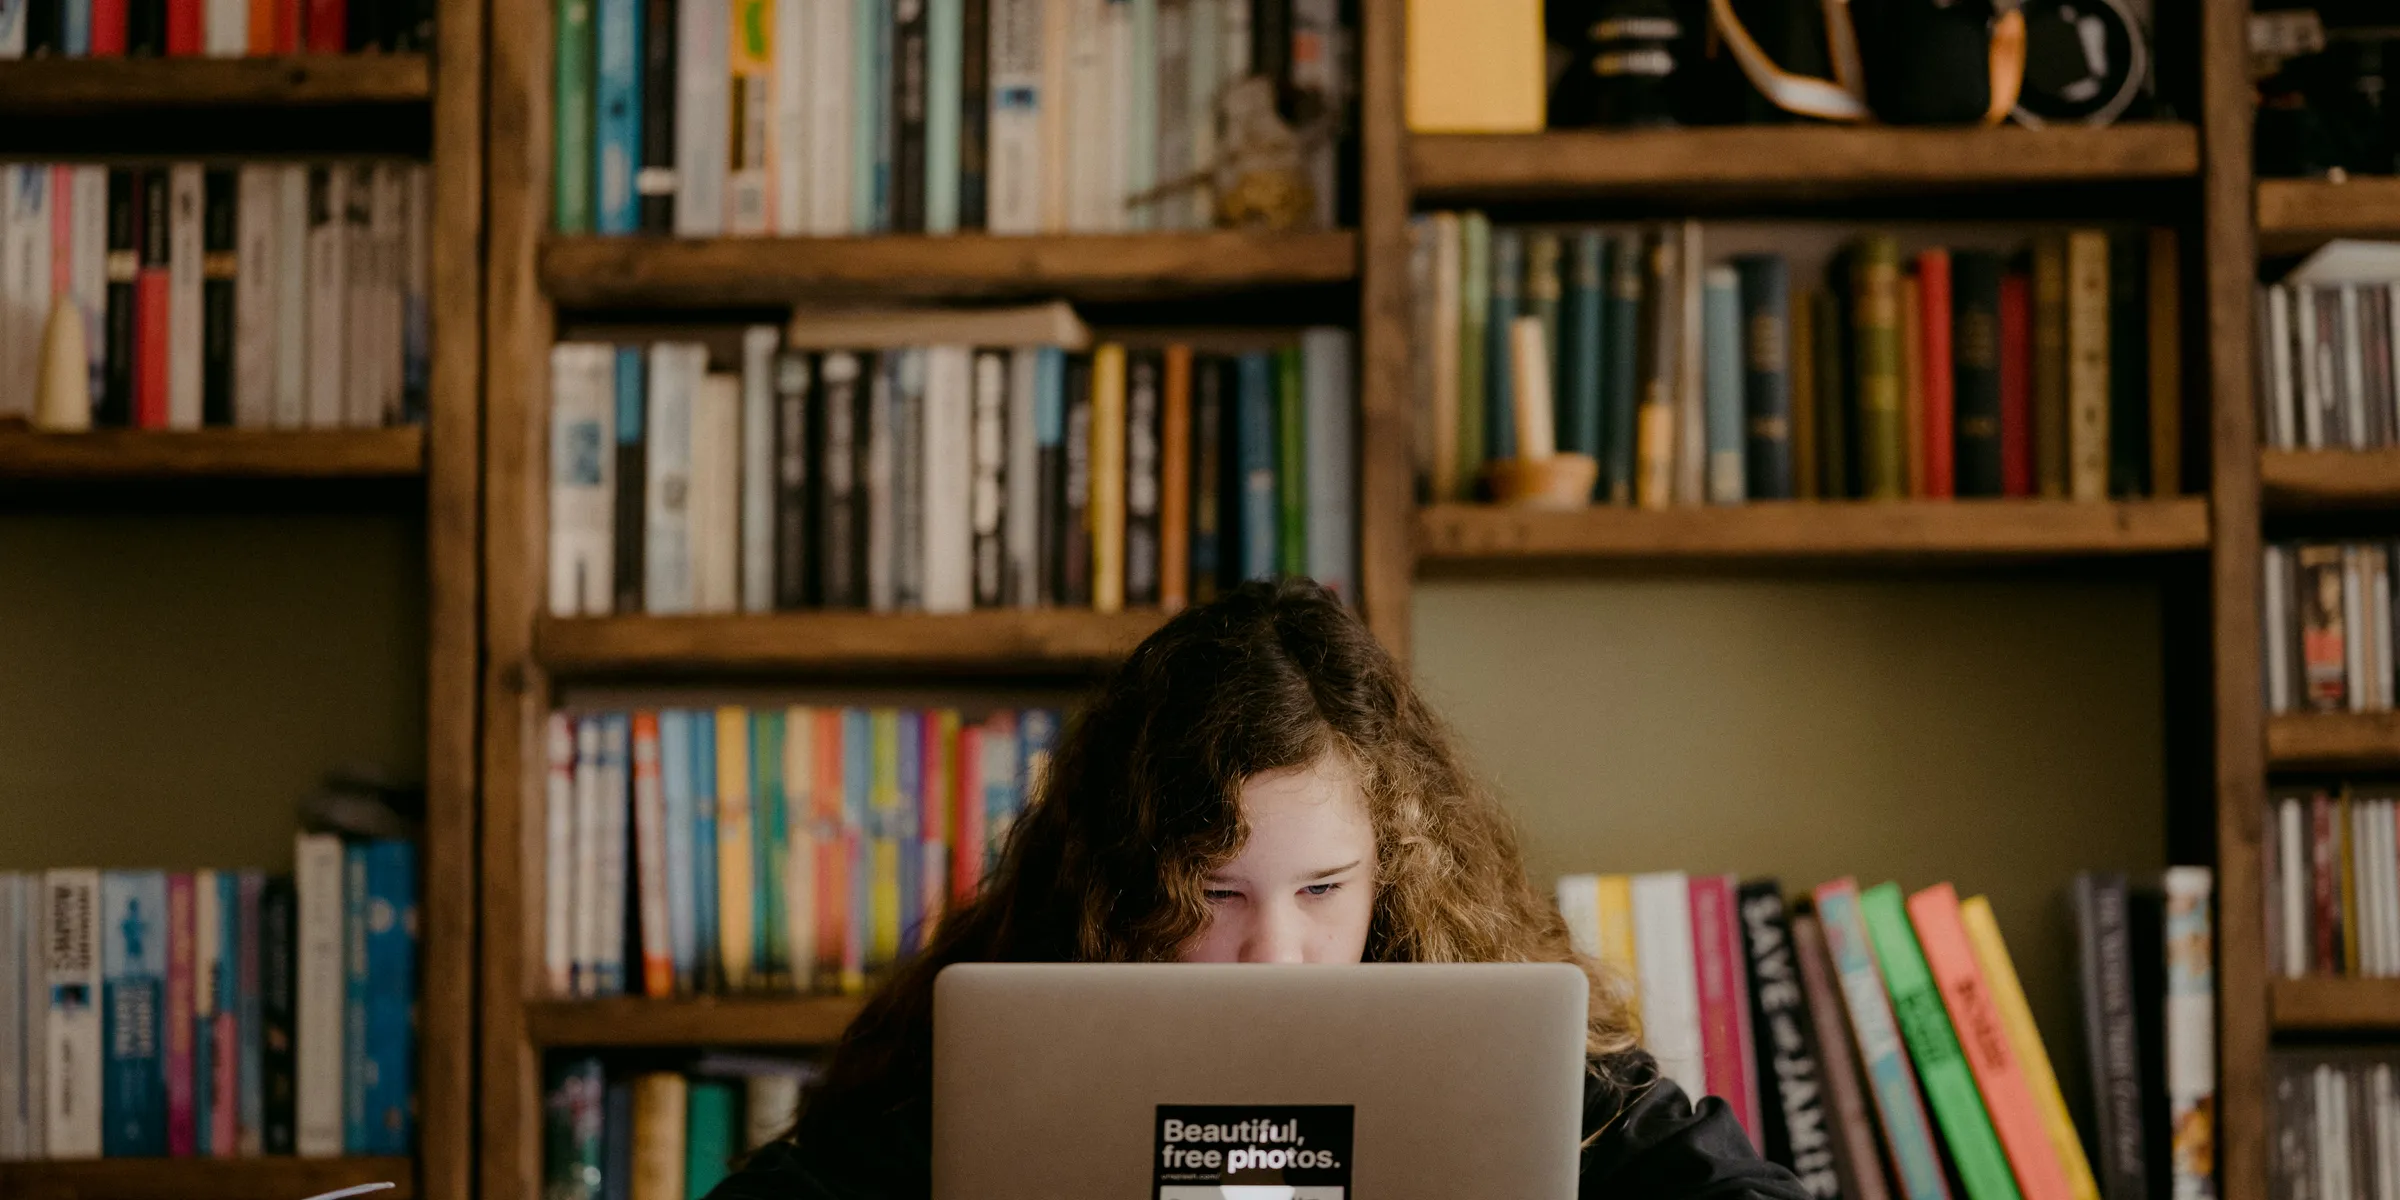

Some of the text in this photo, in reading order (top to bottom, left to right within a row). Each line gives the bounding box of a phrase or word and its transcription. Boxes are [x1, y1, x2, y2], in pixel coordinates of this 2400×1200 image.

[1743, 896, 1799, 1014] SAVE
[1163, 1118, 1305, 1147] Beautiful,
[1161, 1145, 1341, 1174] free photos.
